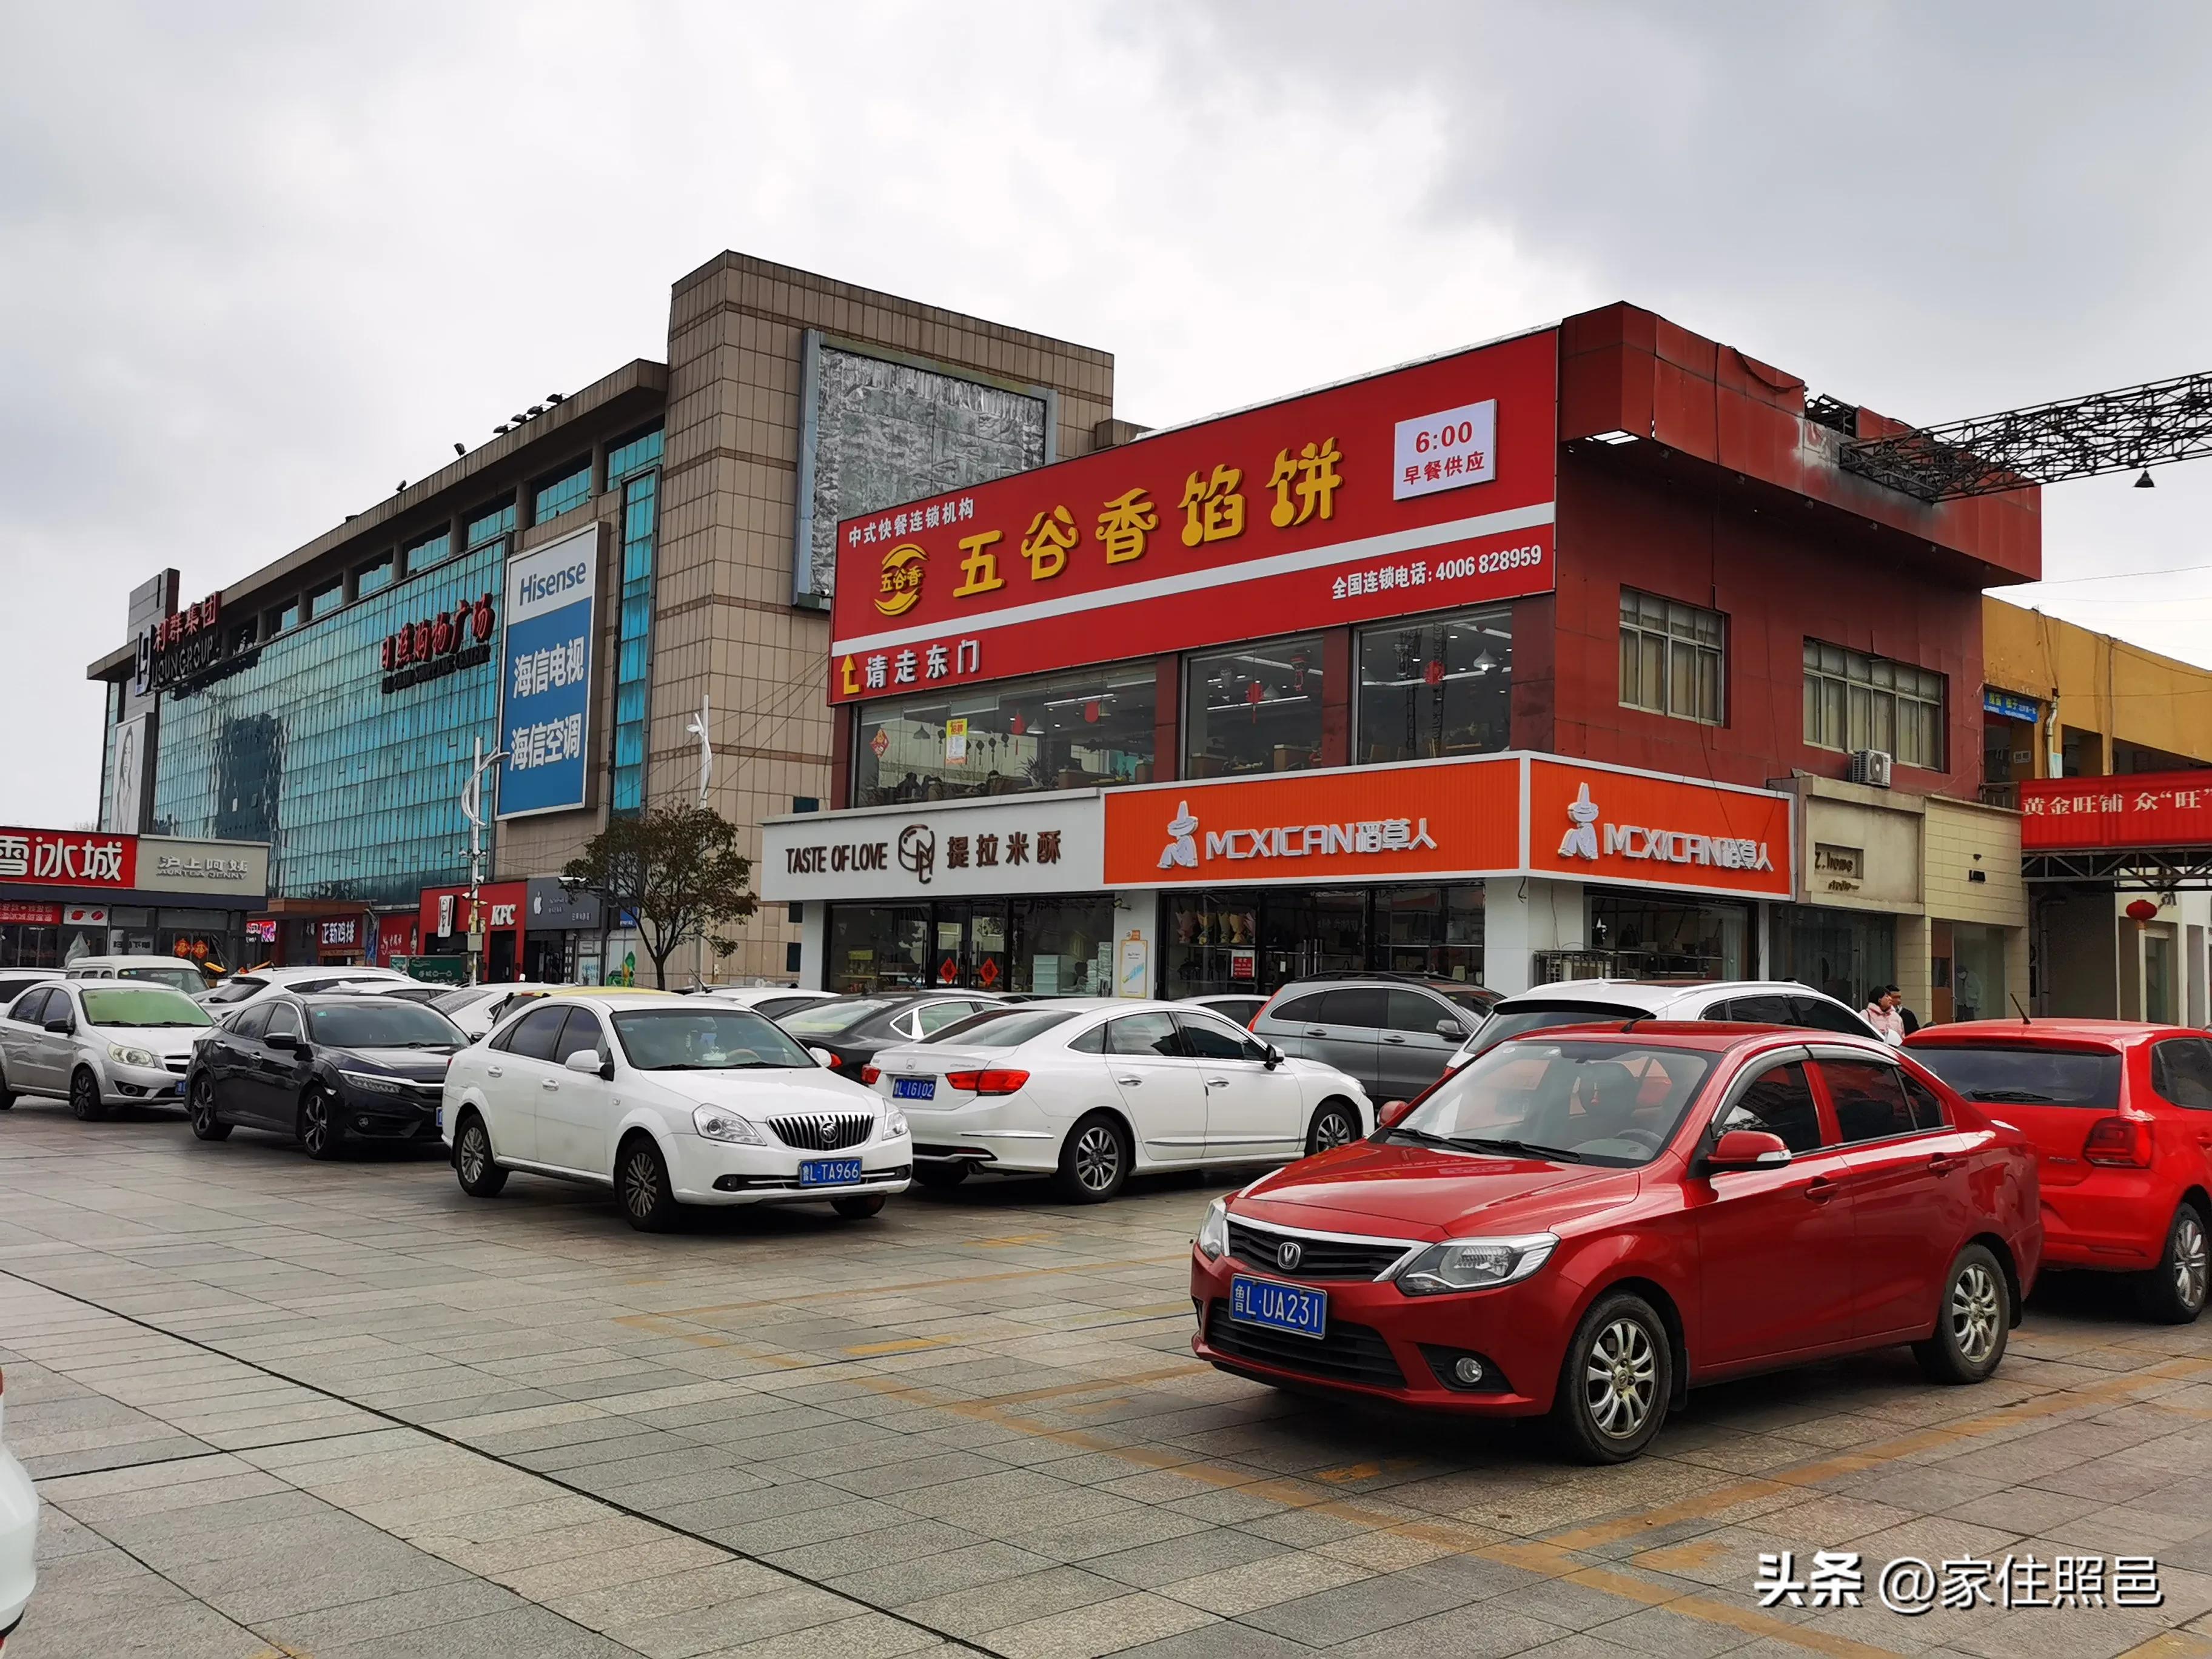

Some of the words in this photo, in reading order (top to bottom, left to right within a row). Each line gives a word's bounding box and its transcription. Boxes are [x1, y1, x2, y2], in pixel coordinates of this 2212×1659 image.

[1415, 420, 1473, 454] 6:00
[1403, 451, 1484, 484] 早餐供应
[849, 497, 974, 548] 中式快餐连锁机构
[953, 437, 1344, 598] 五谷香馅饼
[520, 561, 586, 606] Hisense
[880, 565, 923, 593] 五谷香
[153, 592, 218, 652] 利群集团
[513, 636, 585, 699] 海信电视
[865, 640, 980, 688] 请走东门
[509, 713, 582, 771] 海信空调
[2023, 793, 2124, 816] 黄金旺铺
[785, 846, 827, 874] TASTE
[851, 842, 888, 870] LOVE
[947, 830, 1062, 869] 提拉米酥
[491, 904, 517, 926] KFC
